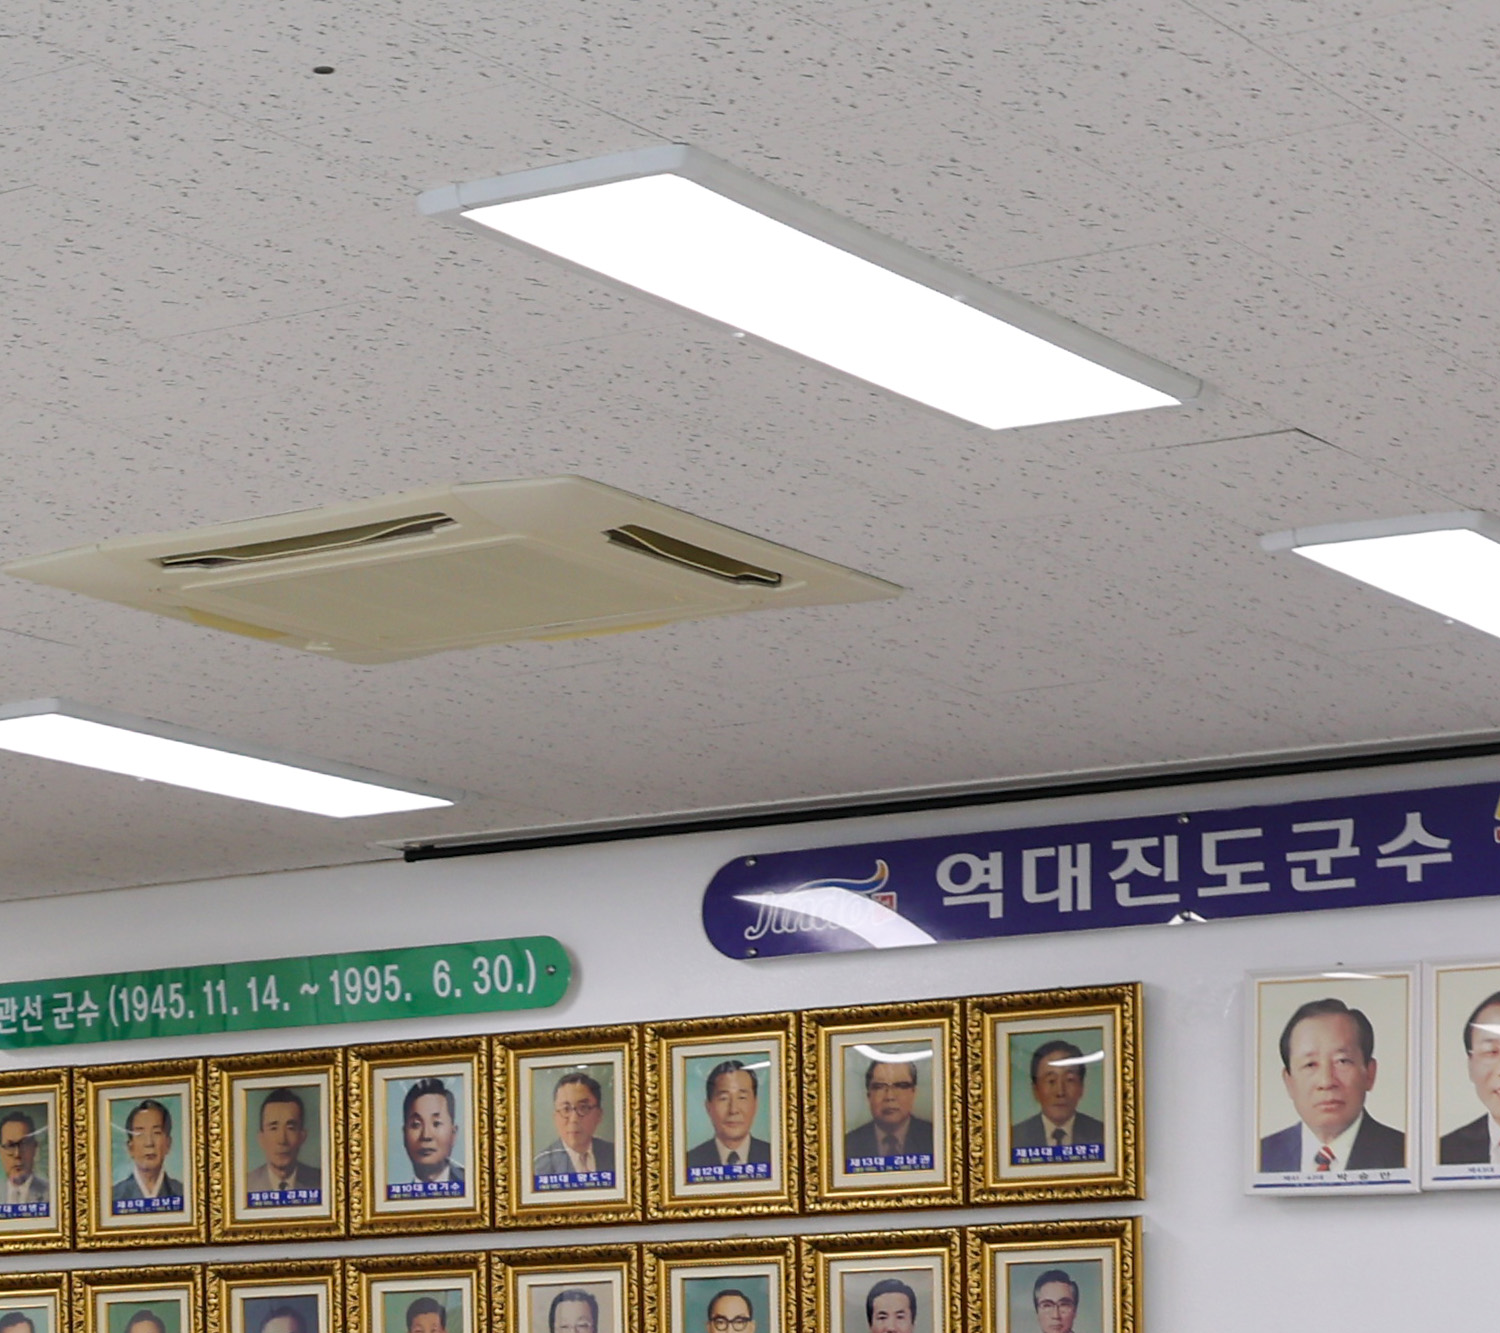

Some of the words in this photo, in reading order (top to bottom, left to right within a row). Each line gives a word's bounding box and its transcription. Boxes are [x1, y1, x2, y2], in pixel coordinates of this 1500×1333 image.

[51, 990, 100, 1030] 군수
[109, 982, 195, 1027] (1945.
[203, 979, 239, 1015] 11.
[246, 975, 291, 1012] 14.
[299, 982, 320, 995] ~
[328, 964, 412, 1005] 1995.
[432, 959, 462, 998] 6.
[472, 948, 536, 995] 30.)
[1016, 1147, 1053, 1157] 제14대
[850, 1157, 885, 1167] 제13대
[691, 1166, 724, 1176] 제12대
[538, 1175, 569, 1184] 제11대
[391, 1184, 423, 1193] 제10대
[251, 1191, 280, 1201] 제9대
[117, 1199, 144, 1209] 제8대
